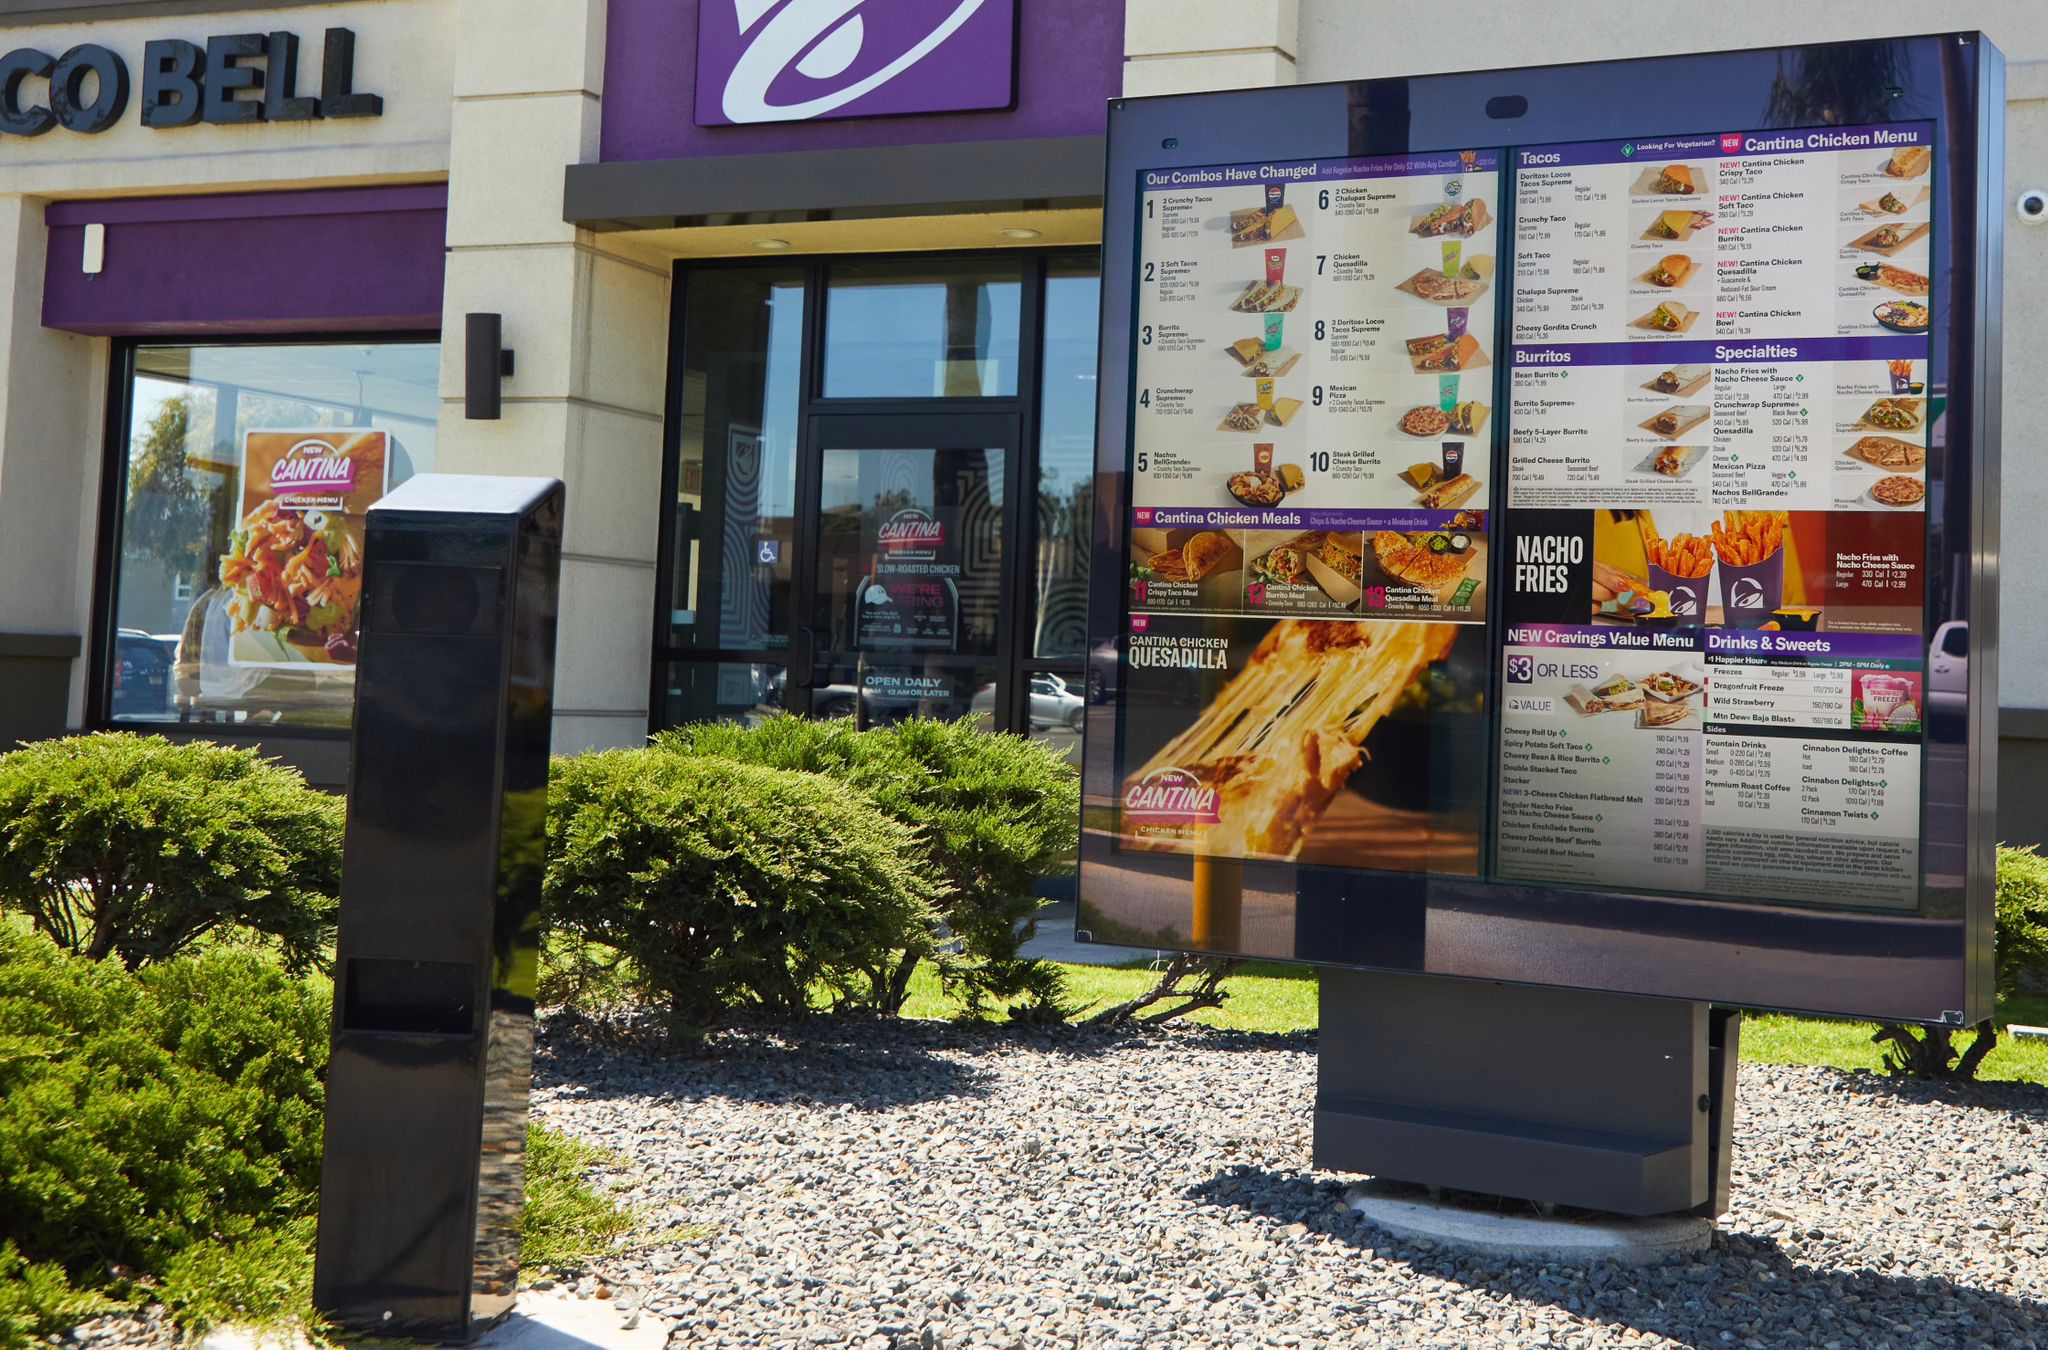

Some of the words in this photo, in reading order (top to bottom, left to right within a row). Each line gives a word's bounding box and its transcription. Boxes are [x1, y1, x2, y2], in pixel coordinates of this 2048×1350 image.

[141, 27, 383, 129] BELL
[1722, 138, 1739, 147] NEW
[1745, 138, 1804, 152] Cantina
[1807, 134, 1870, 148] Chicken
[1874, 130, 1918, 144] Menu
[1521, 152, 1560, 164] Tacos
[1147, 173, 1169, 185] Our
[1172, 171, 1222, 183] Combos
[1226, 168, 1256, 180] Have
[1259, 163, 1317, 179] Changed
[1147, 200, 1154, 218] 1
[1318, 190, 1329, 210] 6
[1144, 263, 1154, 281] 2
[1316, 256, 1326, 275] 7
[1142, 326, 1152, 345] 3
[1314, 320, 1325, 340] 8
[1516, 325, 1541, 334] Cheesy
[1516, 350, 1571, 363] Burritos
[1715, 345, 1798, 361] Specialties
[1140, 388, 1150, 408] 4
[1312, 386, 1323, 406] 9
[272, 457, 350, 481] CANTINA
[1138, 452, 1148, 472] 5
[1310, 451, 1329, 472] 10
[1155, 511, 1204, 523] Cantina
[1207, 512, 1259, 525] Chicken
[1262, 513, 1301, 524] Meals
[879, 521, 941, 538] CANTINA
[1516, 535, 1584, 564] NACHO
[1836, 553, 1861, 561] Nacho
[877, 564, 928, 574] SLOW-ROASTED
[930, 565, 960, 574] CHICKEN
[1515, 565, 1568, 593] FRIES
[1385, 594, 1420, 602] Quesadilla
[1130, 636, 1177, 646] CANTINA
[1180, 638, 1228, 648] CHICKEN
[1508, 629, 1542, 642] NEW
[1545, 630, 1606, 647] Cravings
[1610, 632, 1649, 646] Value
[1653, 634, 1694, 647] Menu
[1709, 635, 1758, 649] Drinks
[1761, 637, 1773, 650] &
[1775, 637, 1831, 652] Sweets
[1129, 646, 1227, 670] QUESADILLA
[1508, 657, 1532, 681] $3
[1537, 664, 1558, 677] OR
[1562, 664, 1598, 678] LESS
[866, 676, 900, 686] OPEN
[905, 678, 941, 687] DAILY
[1713, 682, 1757, 692] Dragonfruit
[1520, 700, 1551, 711] VALUE
[1732, 698, 1774, 708] Strawberry
[1504, 727, 1530, 736] Cheesy
[1706, 740, 1740, 748] Fountain
[1705, 781, 1739, 789] Premium
[1764, 784, 1790, 792] Coffee
[1126, 786, 1216, 810] CANTINA
[1801, 808, 1841, 817] Cinnamon
[1843, 810, 1868, 819] Twists
